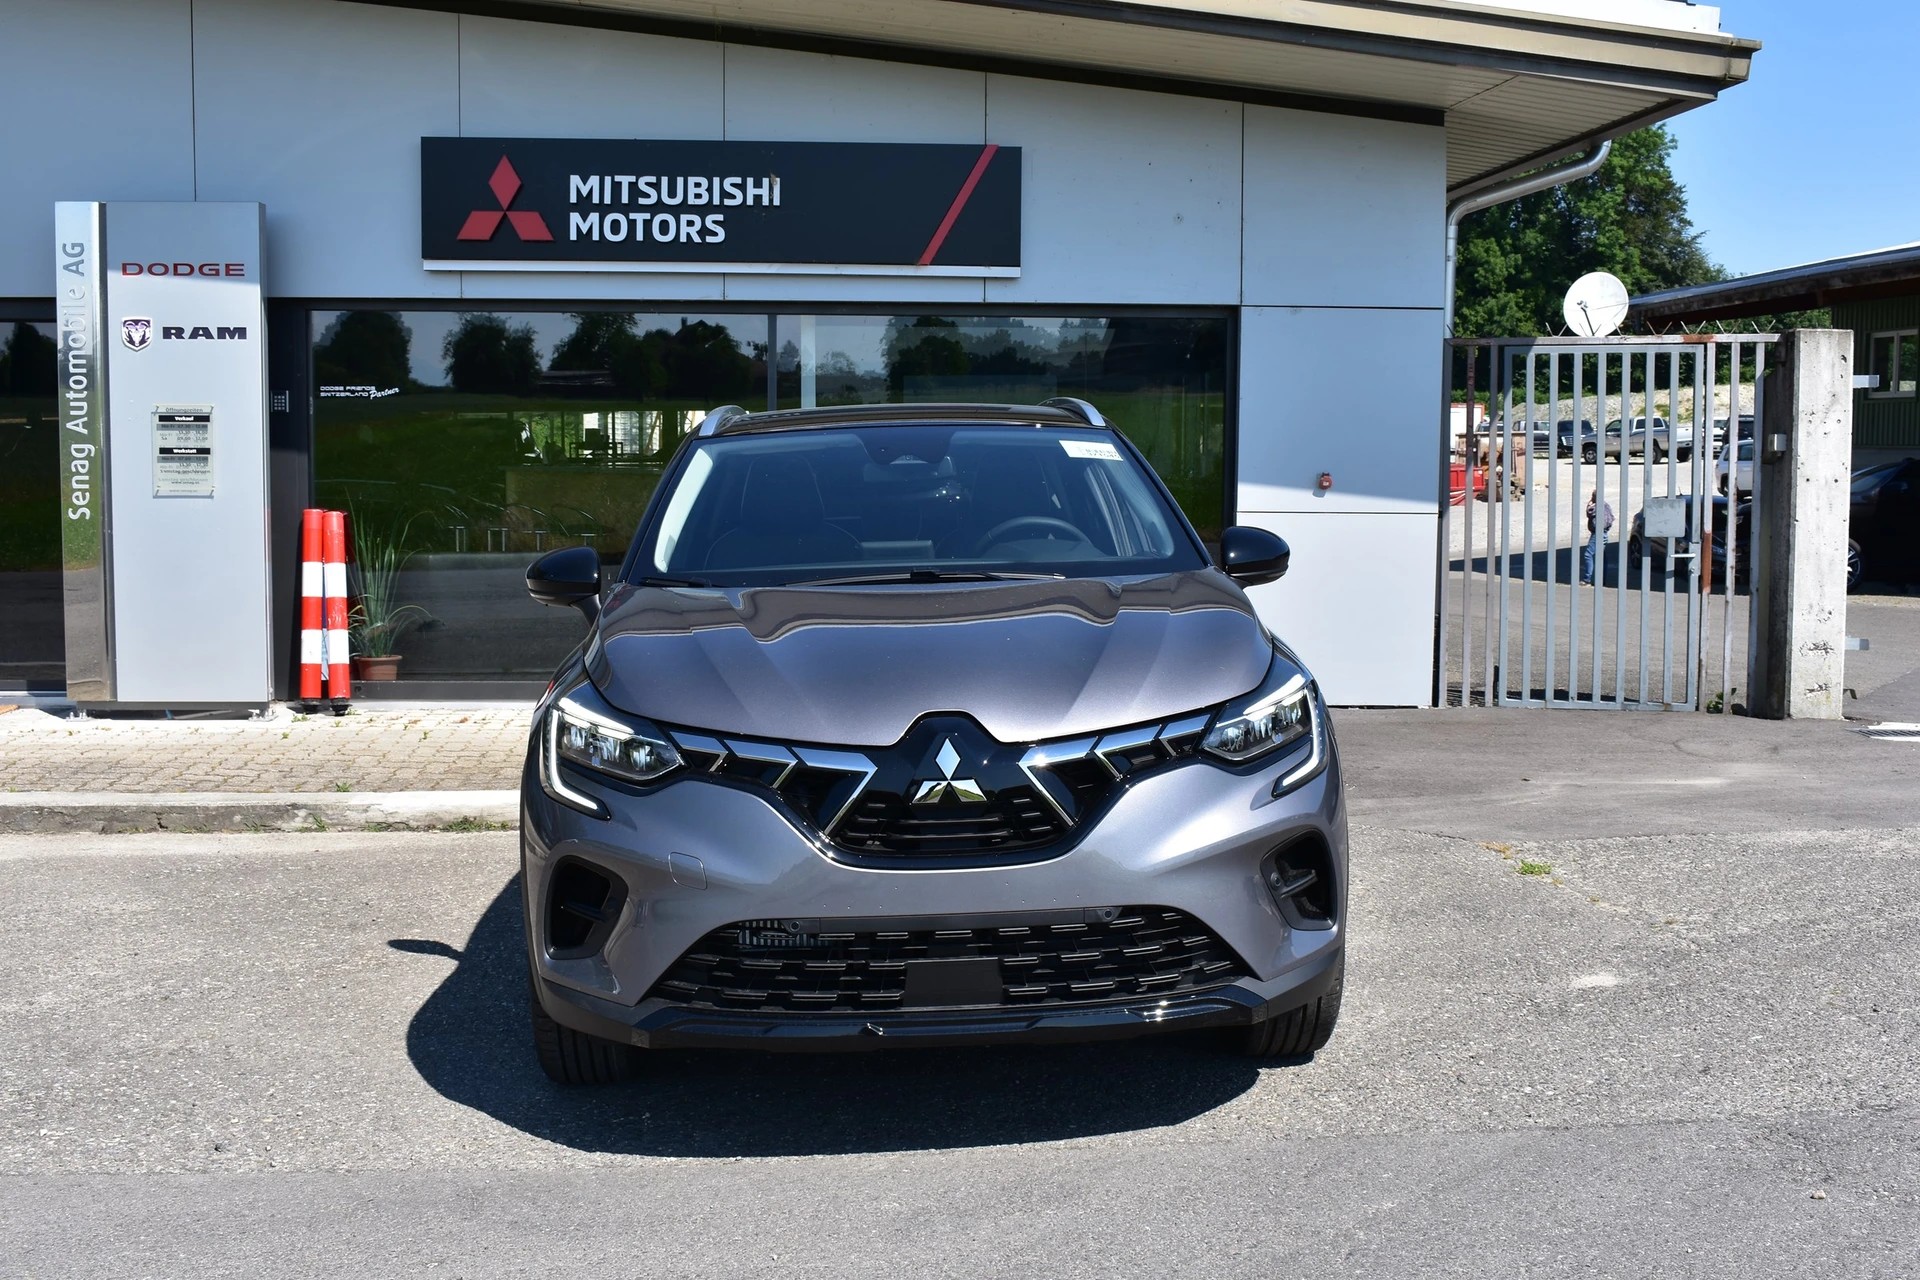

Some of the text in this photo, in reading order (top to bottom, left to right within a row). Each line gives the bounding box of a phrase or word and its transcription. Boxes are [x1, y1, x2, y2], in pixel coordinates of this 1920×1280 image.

[569, 174, 782, 207] MITSUBISHI
[569, 212, 726, 244] MOTORS
[121, 262, 246, 277] DODGE
[162, 326, 248, 340] RAM
[60, 242, 96, 522] Senag Automobile AG
[369, 387, 400, 400] Partner
